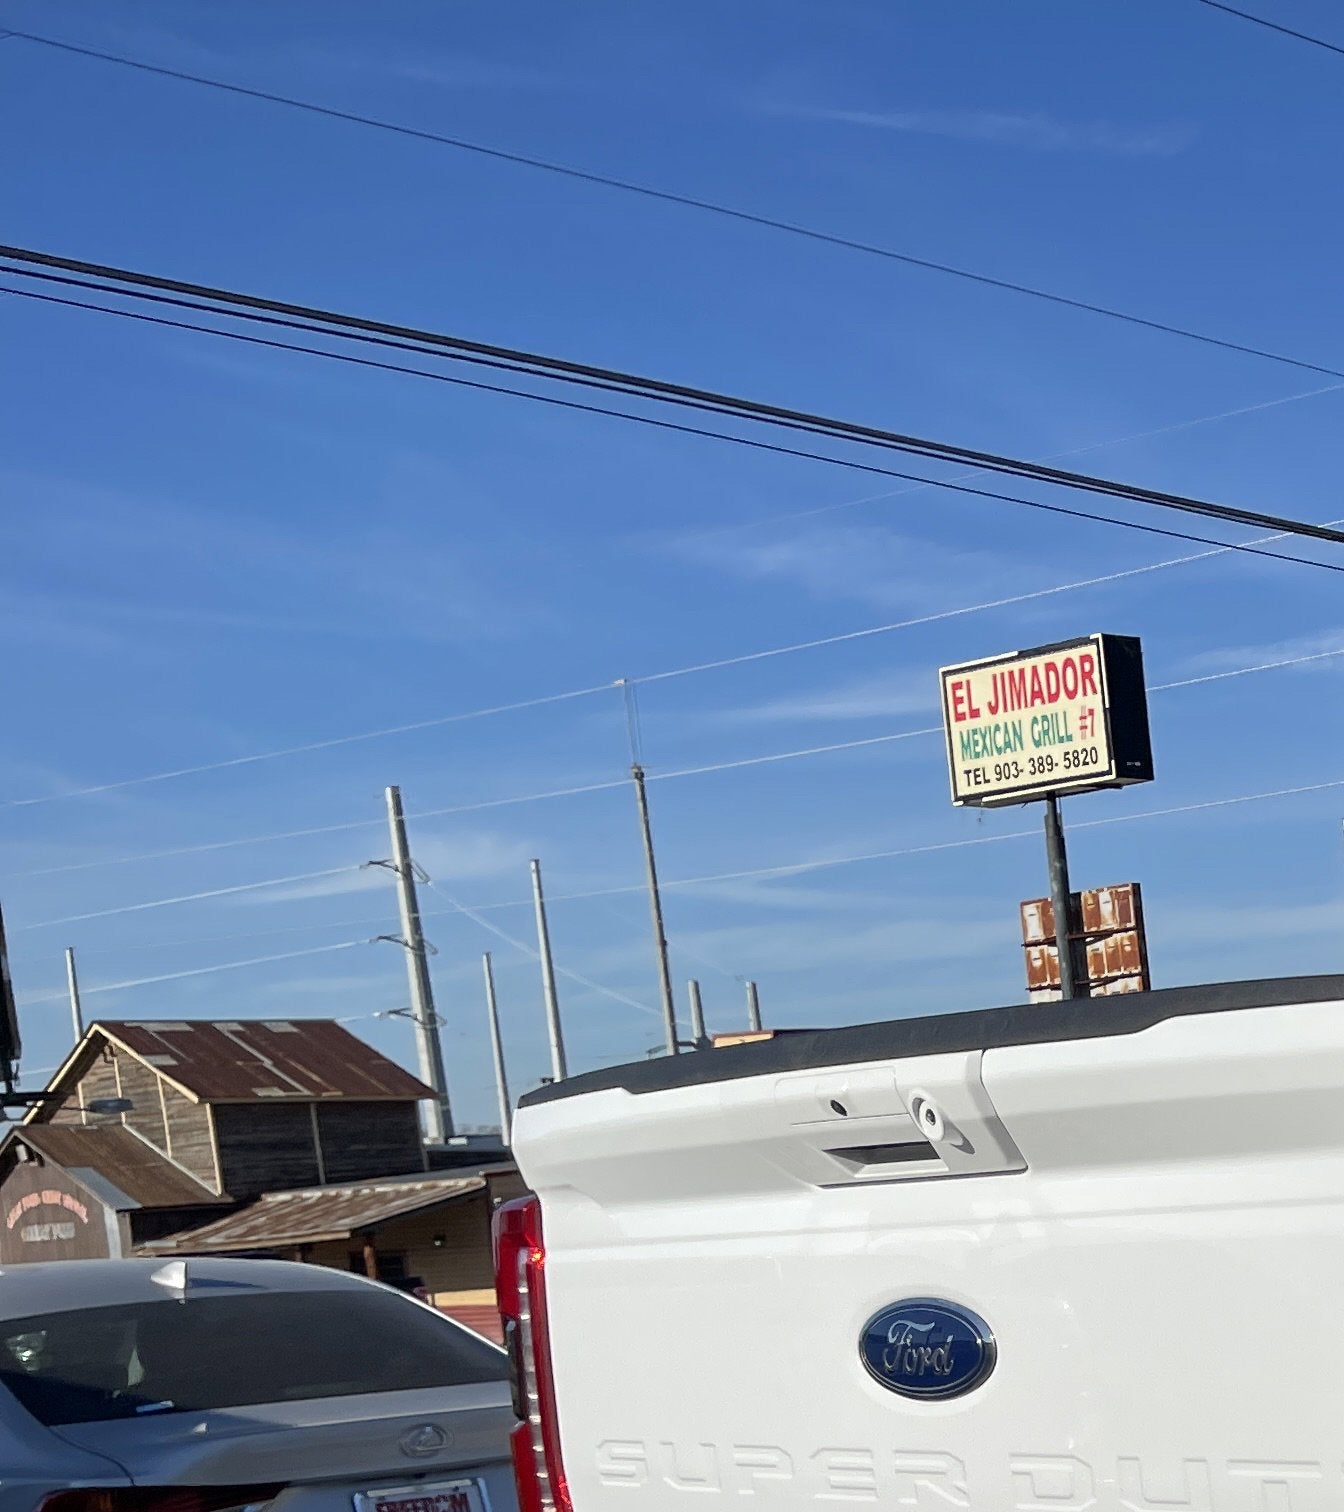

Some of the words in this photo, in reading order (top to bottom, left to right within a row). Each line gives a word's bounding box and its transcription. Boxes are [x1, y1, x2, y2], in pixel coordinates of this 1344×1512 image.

[951, 679, 981, 723] EL
[987, 653, 1098, 715] JIMADOR
[959, 718, 1024, 762] MEXICAN
[1031, 710, 1073, 748] GRILL
[1078, 704, 1096, 740] #7
[963, 766, 991, 787] TEL
[882, 1319, 955, 1376] Ford
[596, 1439, 972, 1508] SUPER
